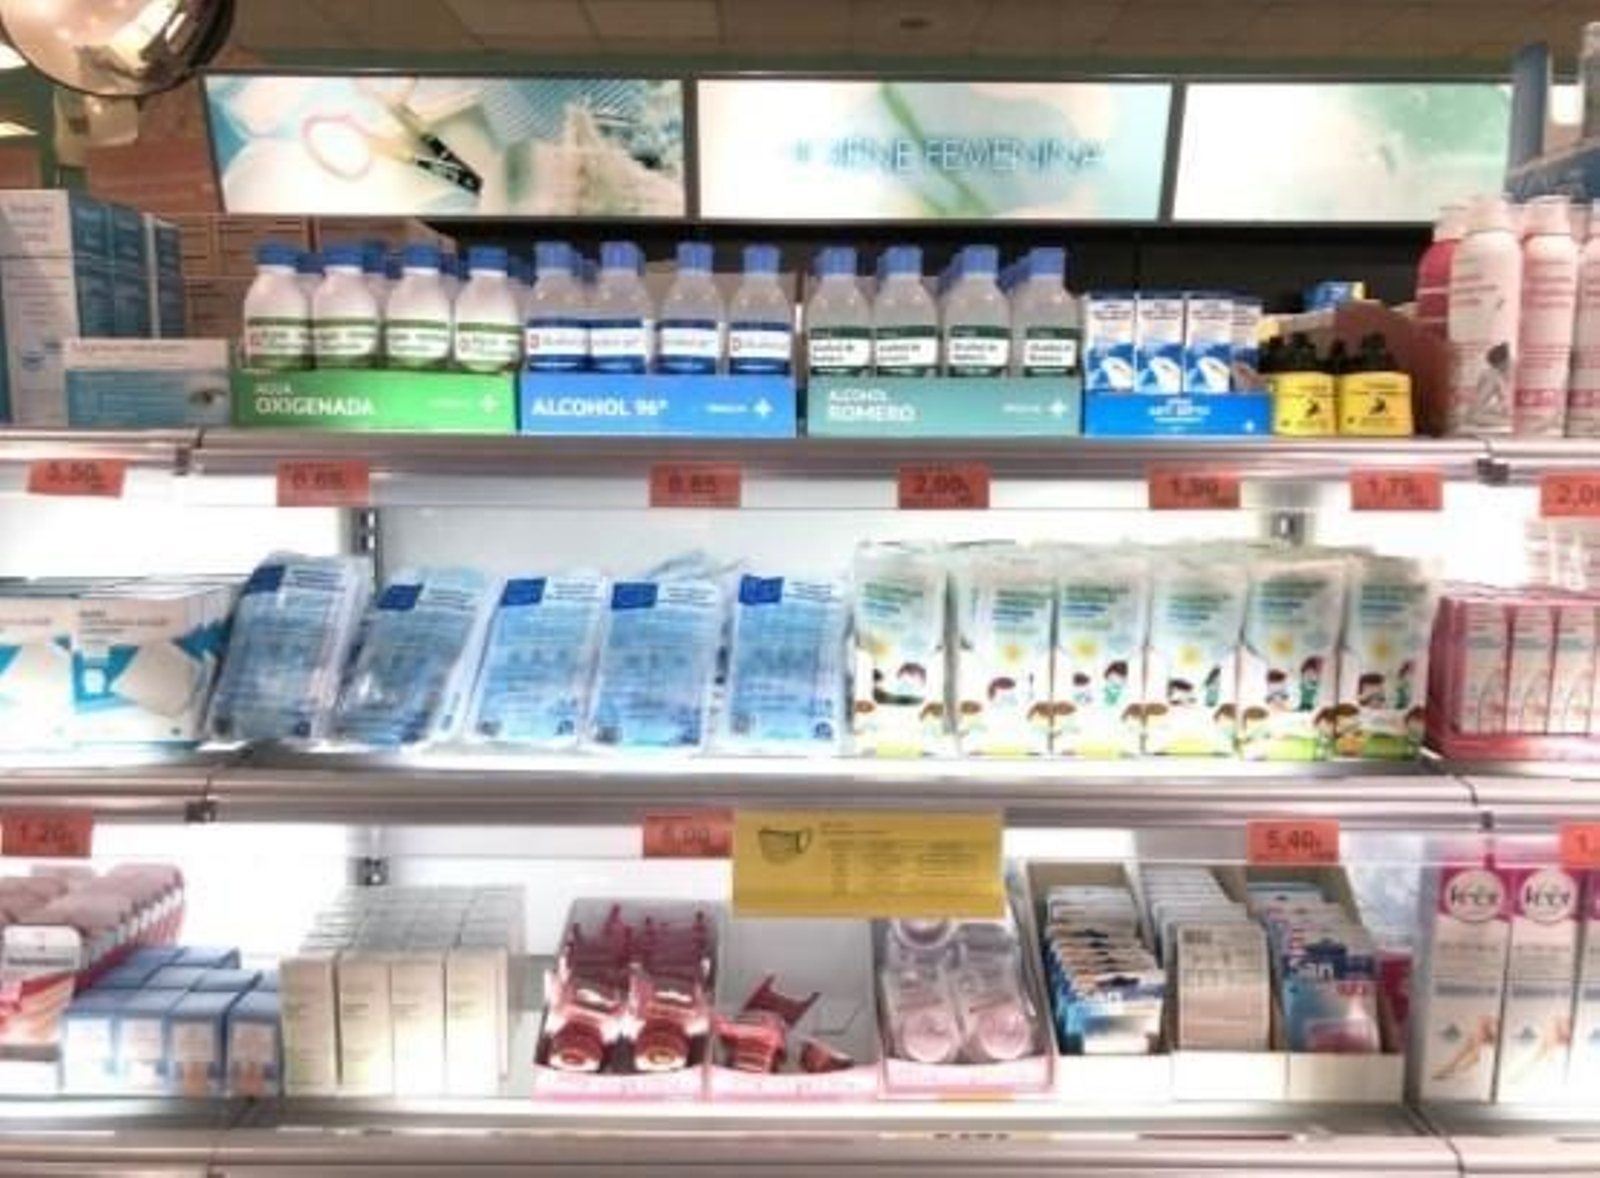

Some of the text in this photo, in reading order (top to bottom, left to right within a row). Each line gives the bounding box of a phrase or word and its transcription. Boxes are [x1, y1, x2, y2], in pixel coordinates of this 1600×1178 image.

[255, 397, 376, 417] OXIGENADA
[532, 397, 632, 417] ALCOHOL
[829, 402, 916, 422] ROMERO
[1556, 483, 1600, 507] 2,0
